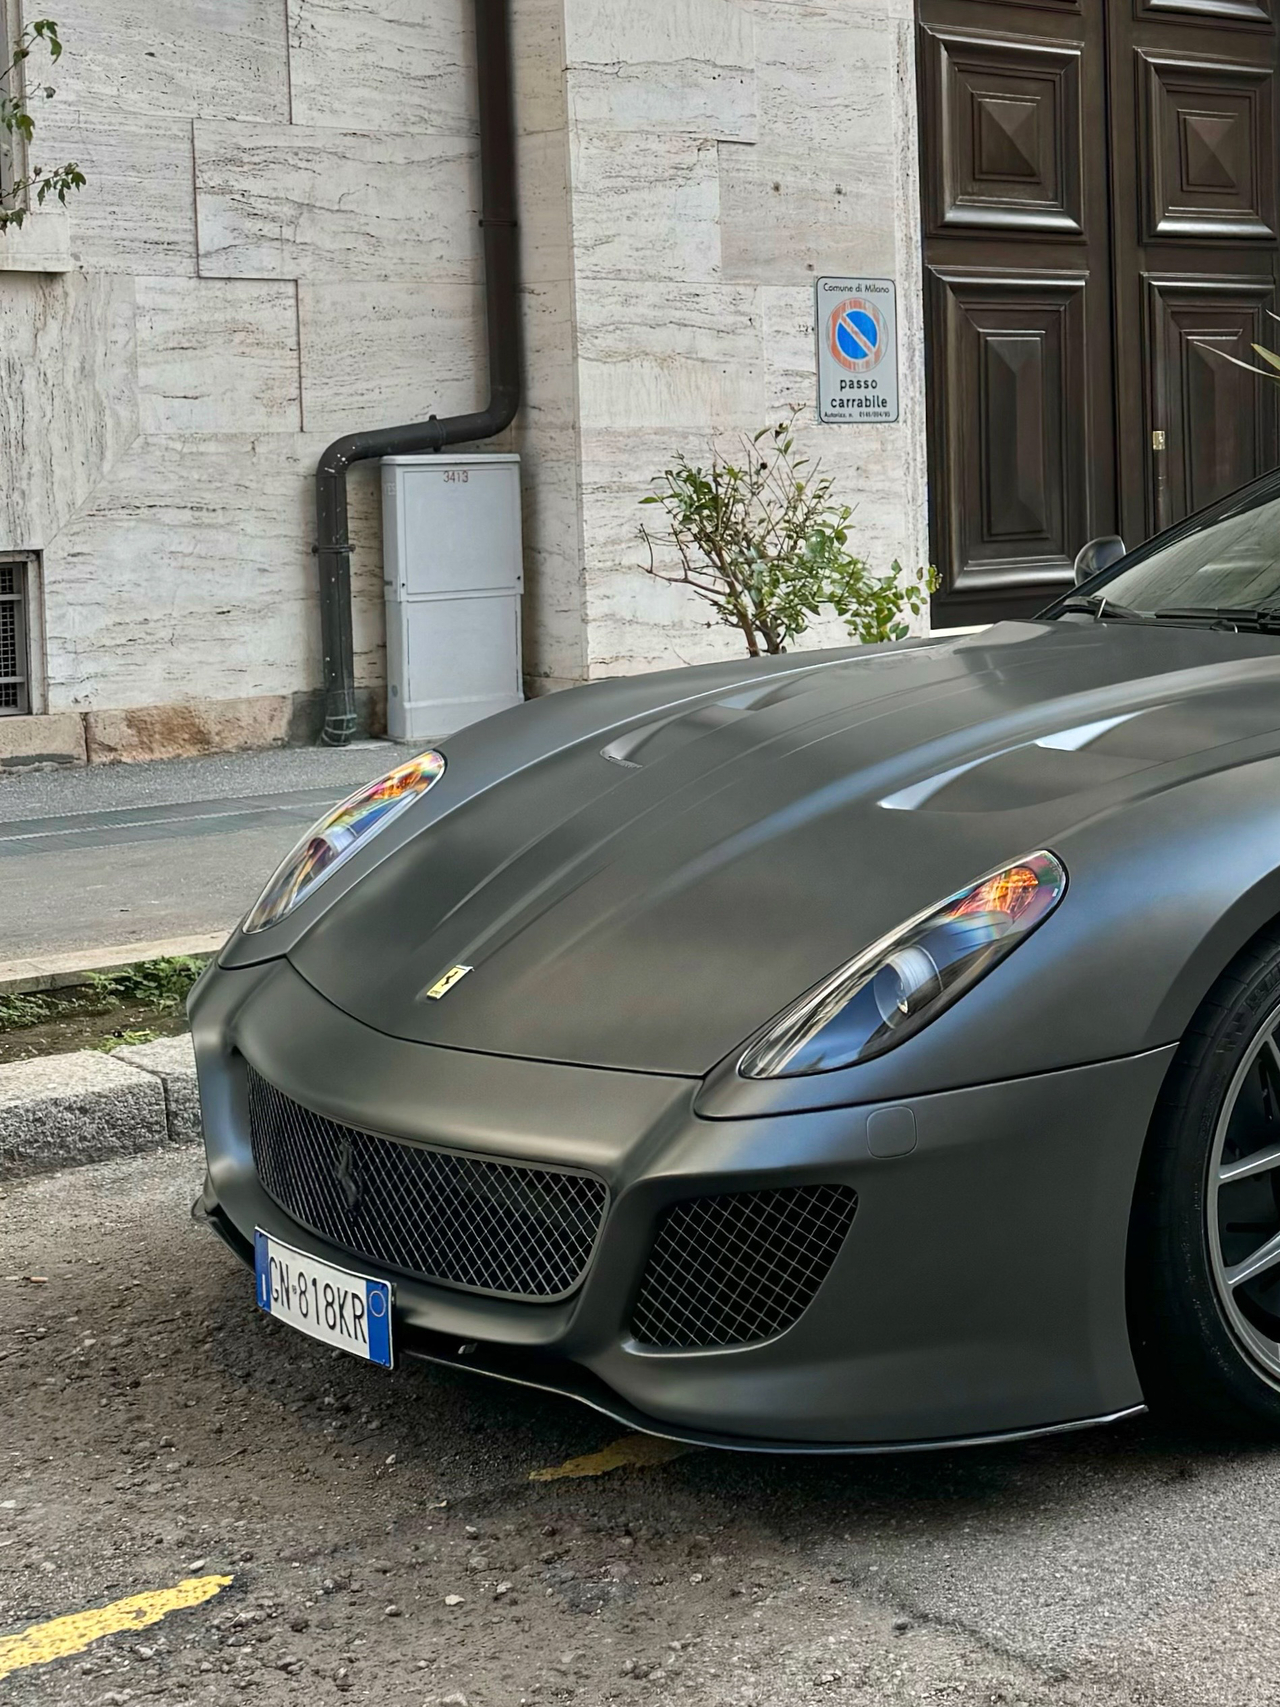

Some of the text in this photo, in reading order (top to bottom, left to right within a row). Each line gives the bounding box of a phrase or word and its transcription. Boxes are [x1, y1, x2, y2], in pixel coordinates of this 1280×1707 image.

[823, 282, 890, 294] Comune di Milano
[839, 378, 878, 392] passo
[830, 395, 888, 409] carrabile
[443, 470, 469, 483] 3413
